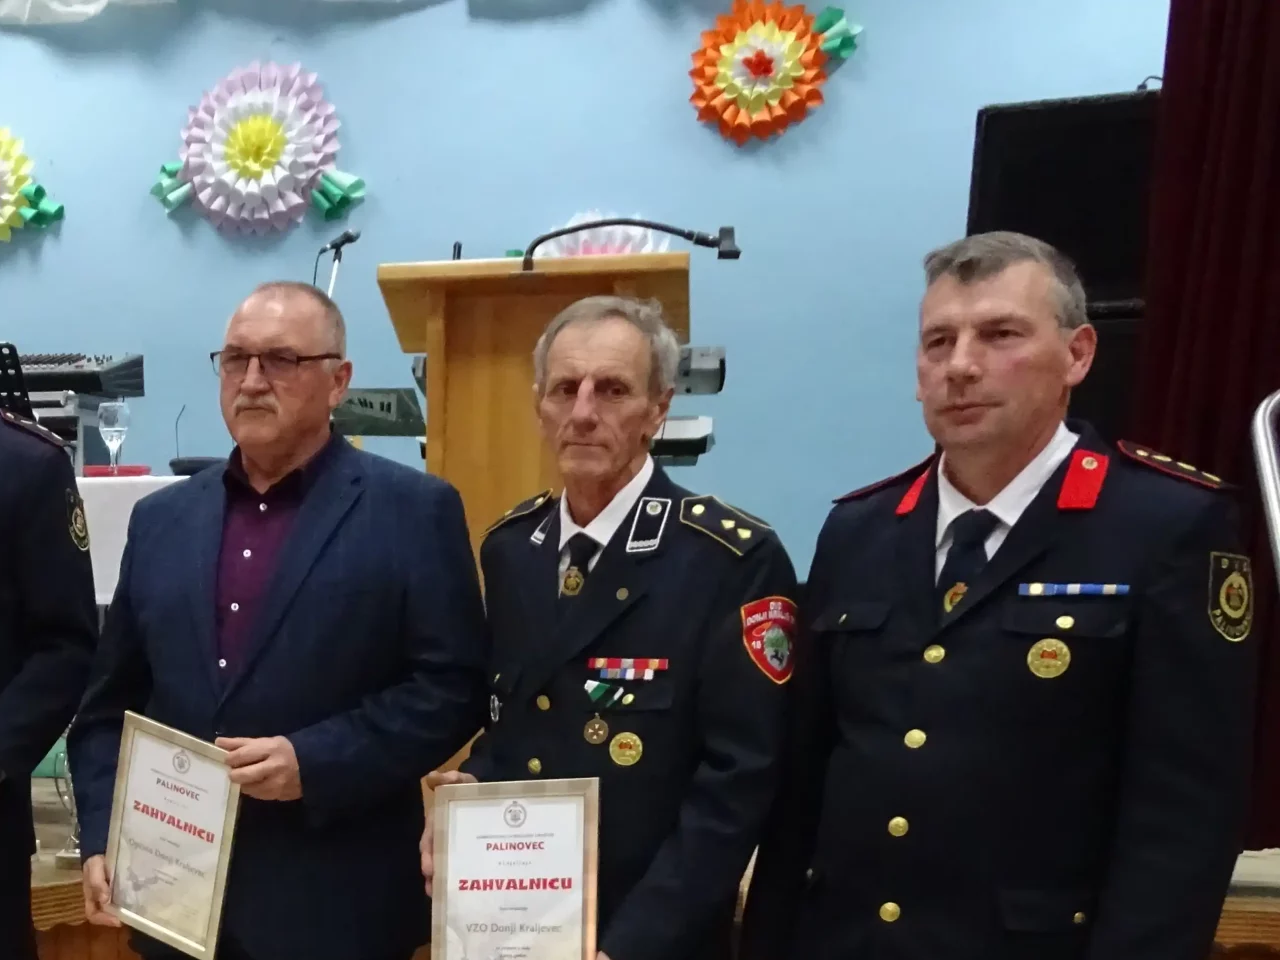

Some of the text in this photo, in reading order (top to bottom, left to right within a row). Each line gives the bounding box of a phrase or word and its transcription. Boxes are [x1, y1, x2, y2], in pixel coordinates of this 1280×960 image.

[155, 777, 200, 801] PALINOVEC
[133, 800, 215, 844] ZAHVALNICU
[486, 841, 545, 851] PALINOVEC
[458, 877, 573, 891] ZAHVALNICU
[466, 923, 488, 933] VZO
[491, 922, 516, 935] Donji
